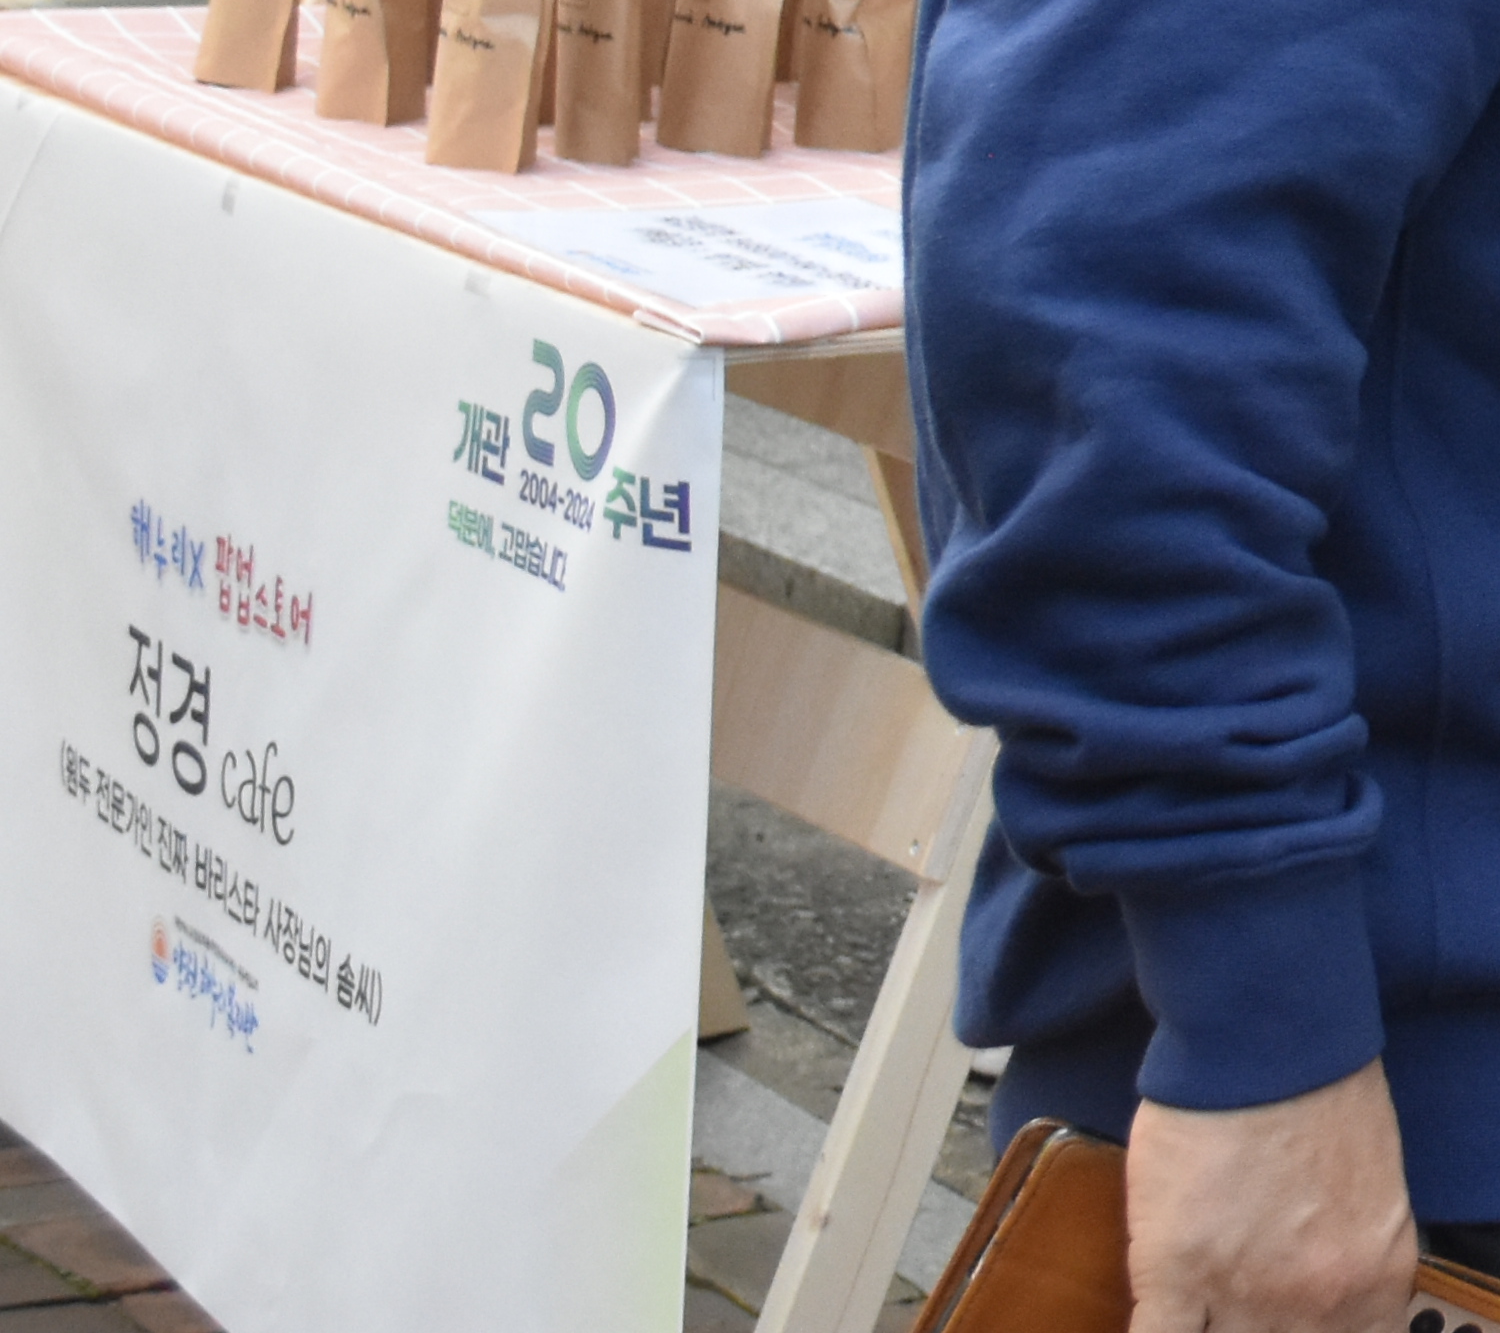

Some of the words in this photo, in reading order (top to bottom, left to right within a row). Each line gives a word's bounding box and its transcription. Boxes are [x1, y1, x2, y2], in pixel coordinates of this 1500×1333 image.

[453, 398, 511, 486] 개관
[521, 337, 617, 482] 20
[602, 465, 692, 553] 주년
[518, 468, 596, 533] 2004-2024
[128, 623, 212, 797] 정경
[220, 740, 296, 846] cafe
[95, 767, 153, 859] 전문가인
[156, 815, 189, 885] 진짜
[194, 842, 260, 937] 바리스타
[263, 897, 332, 994] 사장님의
[335, 952, 384, 1027] 솜씨)
